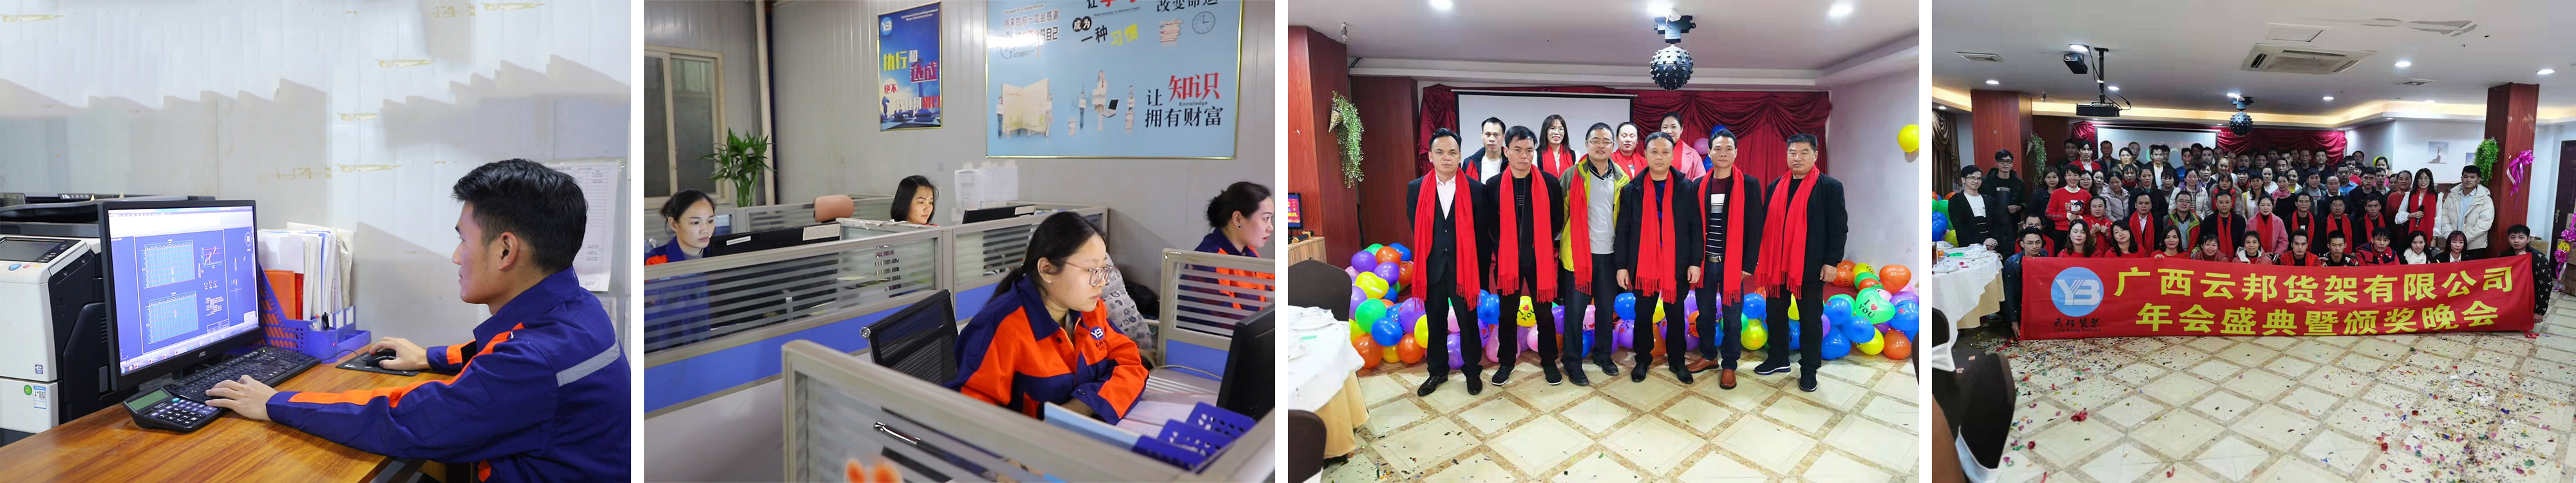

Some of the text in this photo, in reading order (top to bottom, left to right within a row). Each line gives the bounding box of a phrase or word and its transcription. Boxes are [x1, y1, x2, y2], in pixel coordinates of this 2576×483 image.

[1074, 19, 1090, 30] 成为
[1145, 106, 1224, 128] 拥有财富
[2114, 266, 2514, 305] 广西云邦货架有限公司
[1859, 304, 1875, 318] YOU
[2136, 300, 2499, 336] 年会盛典暨颁奖晚会
